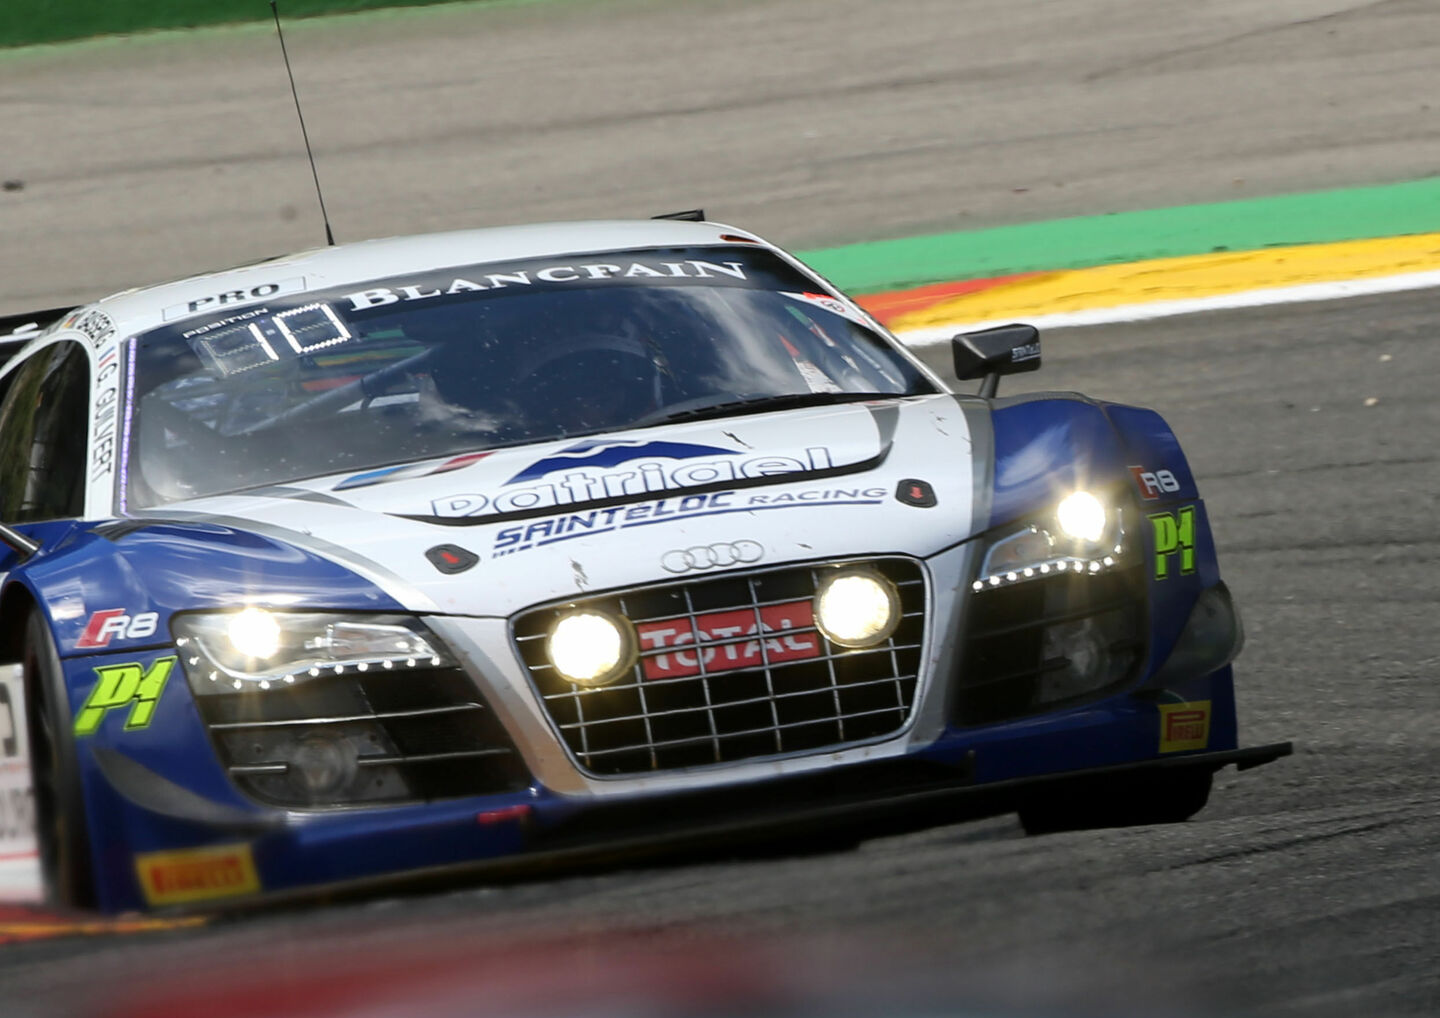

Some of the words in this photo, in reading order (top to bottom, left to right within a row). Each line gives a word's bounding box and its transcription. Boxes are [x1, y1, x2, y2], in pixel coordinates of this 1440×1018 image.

[189, 283, 280, 313] PRO
[342, 259, 751, 312] BLANCPAIN
[182, 308, 269, 338] POSITION
[748, 487, 888, 505] RACING
[1140, 469, 1181, 494] R8
[1146, 505, 1196, 580] P1
[94, 611, 159, 643] R8
[640, 618, 814, 671] TOTAL
[74, 655, 178, 737] P1
